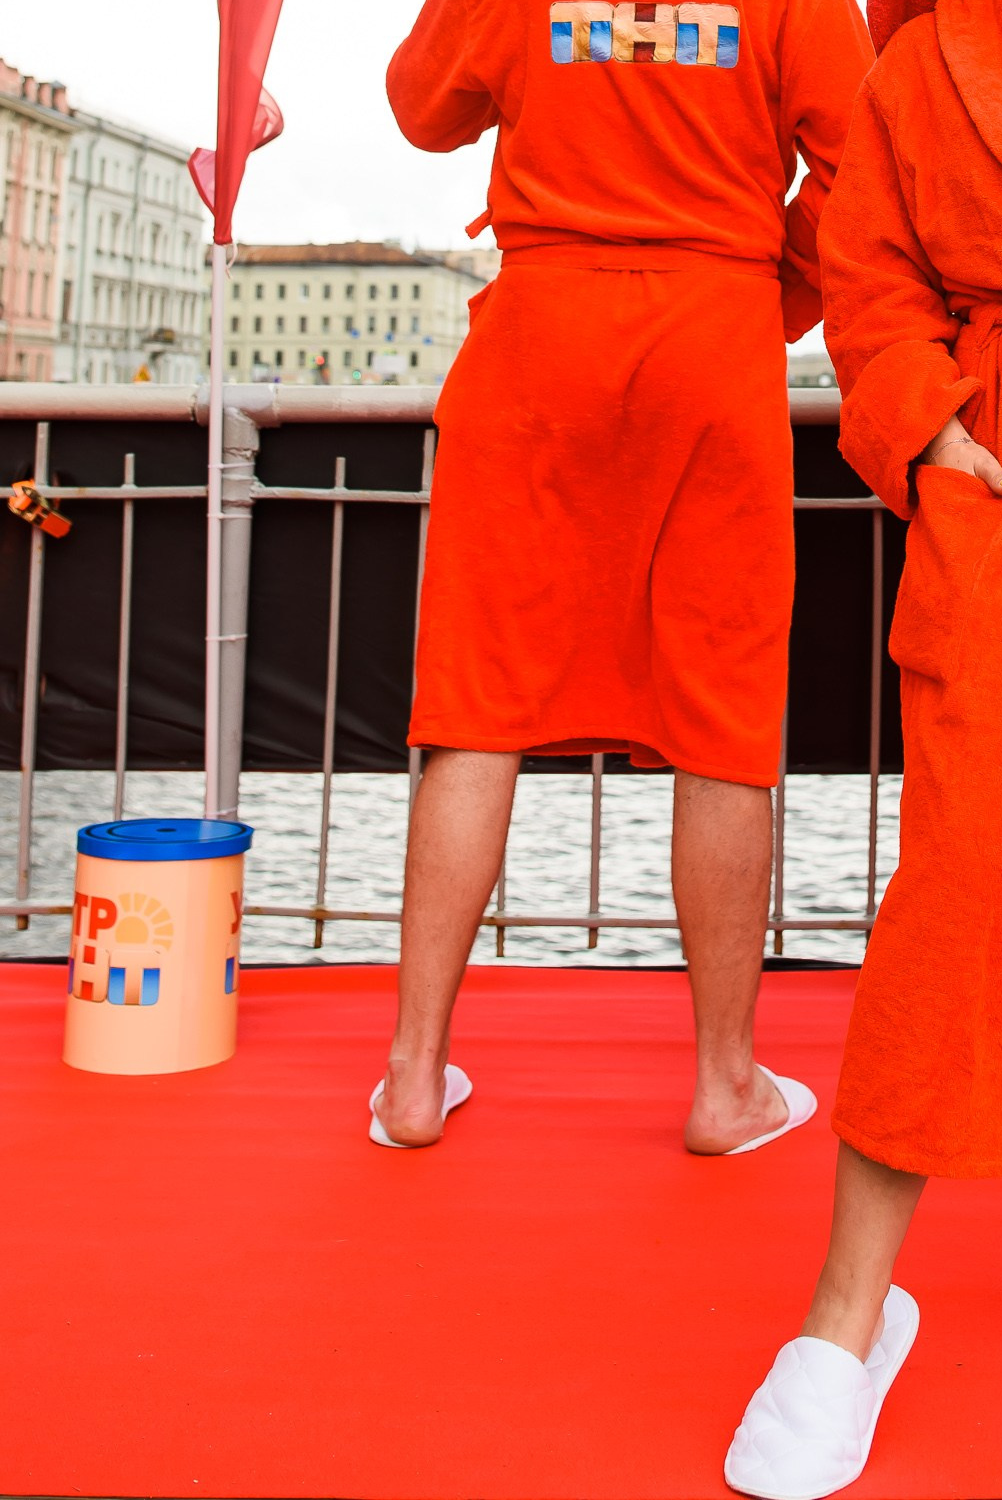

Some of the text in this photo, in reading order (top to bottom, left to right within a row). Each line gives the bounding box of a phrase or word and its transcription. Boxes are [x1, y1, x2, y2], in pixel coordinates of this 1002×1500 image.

[549, 0, 741, 69] ТНТ
[74, 891, 118, 940] ТР
[68, 944, 160, 1006] НТ
